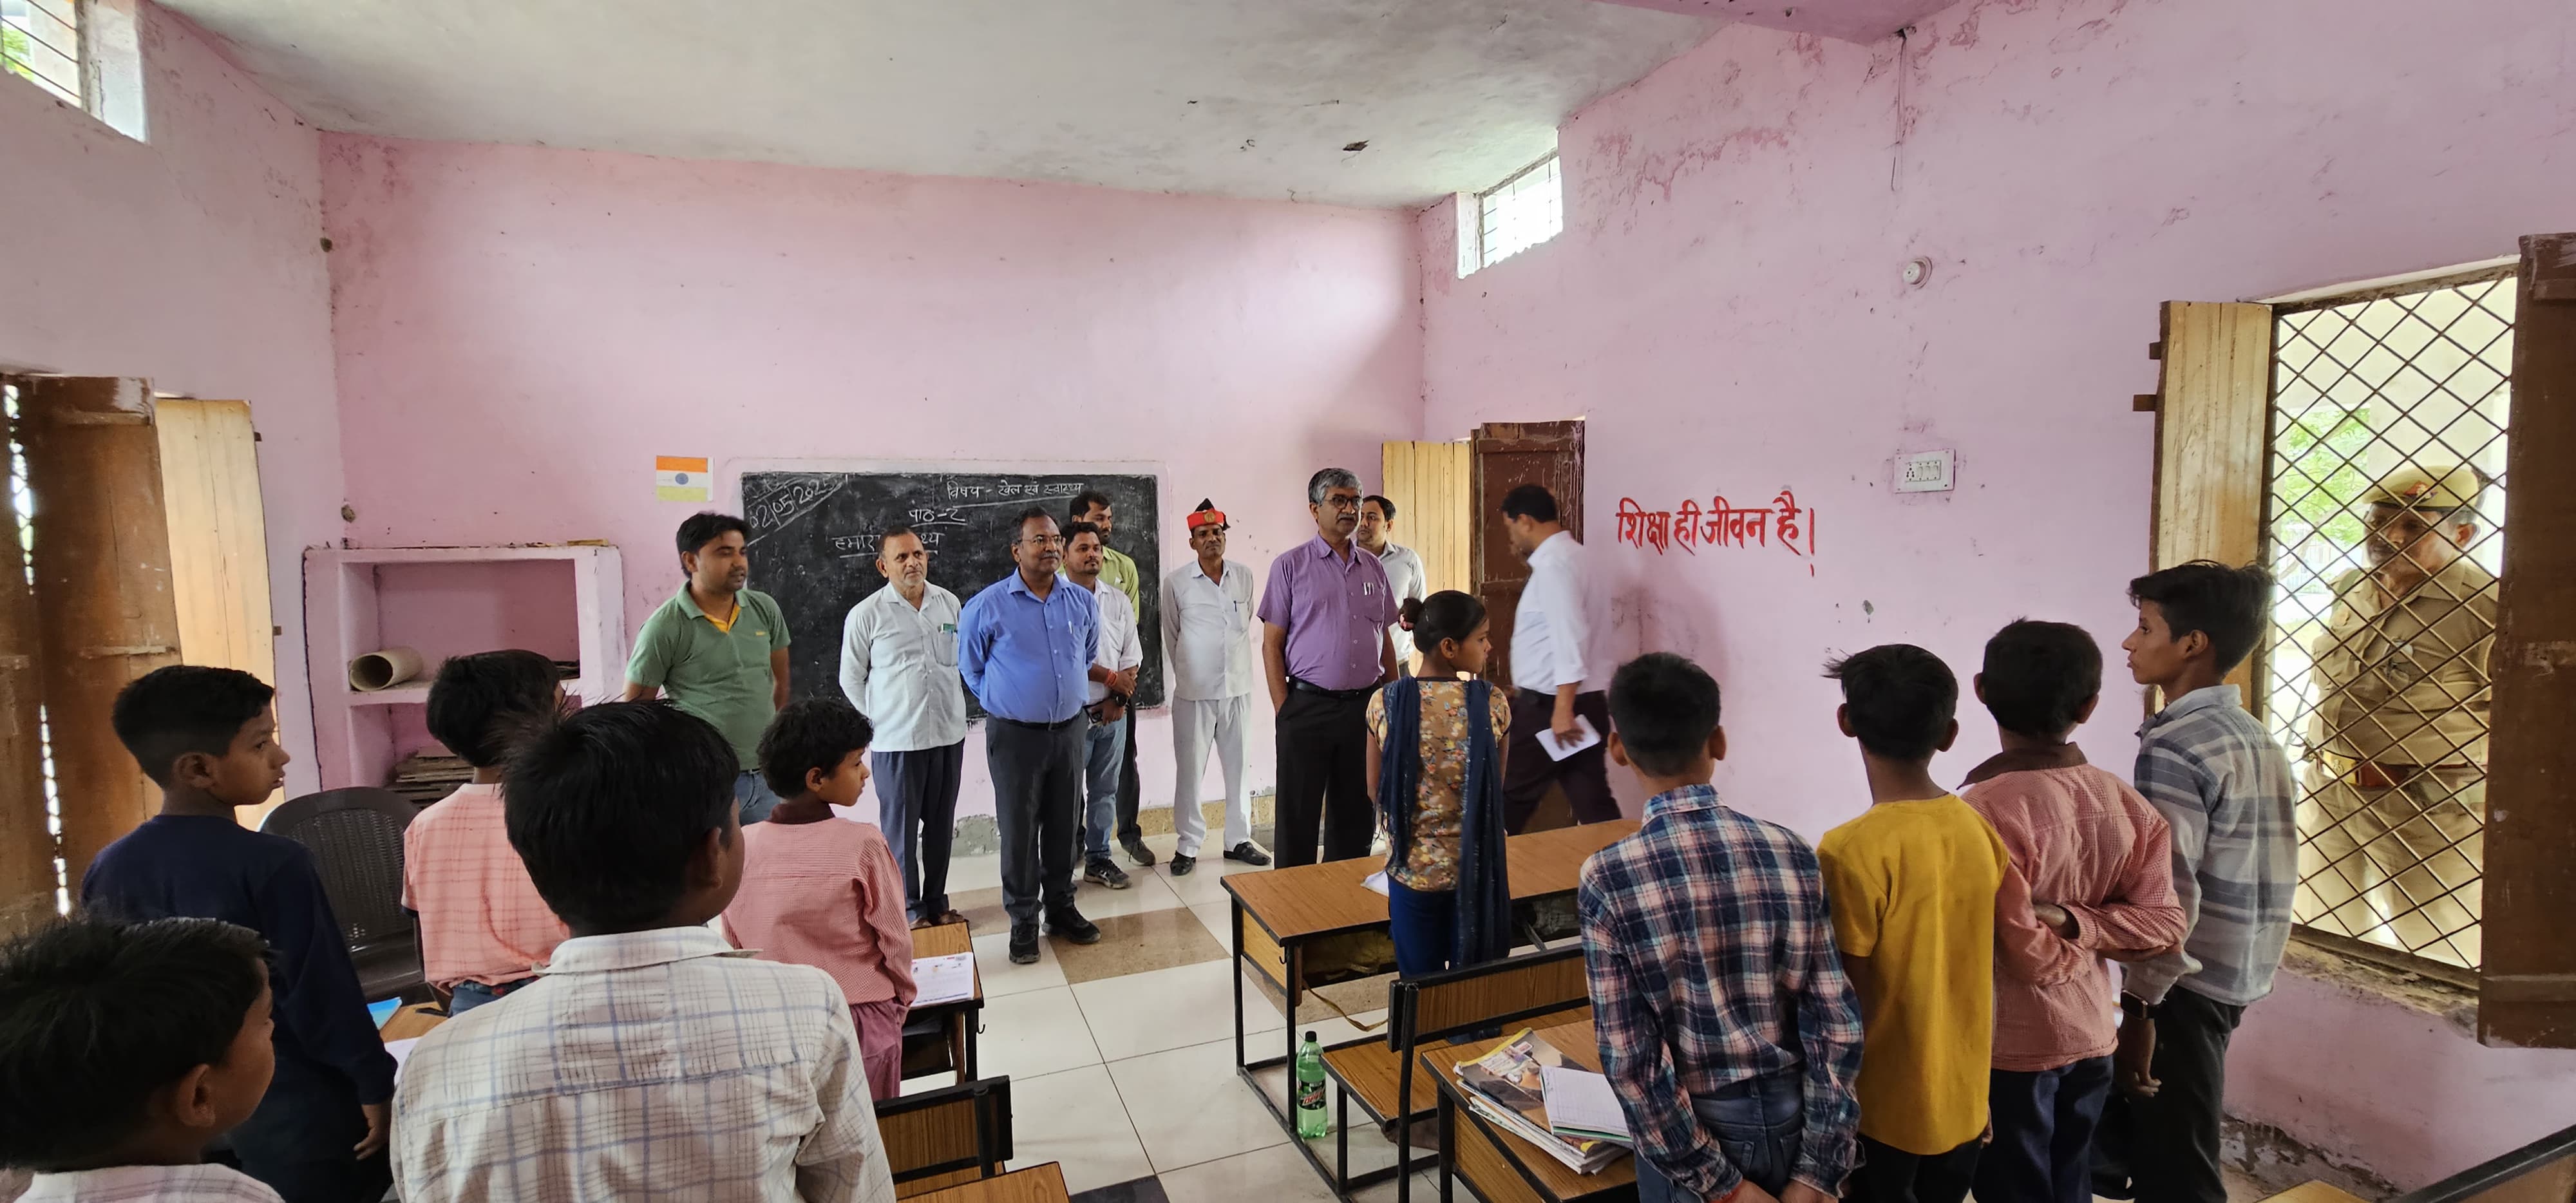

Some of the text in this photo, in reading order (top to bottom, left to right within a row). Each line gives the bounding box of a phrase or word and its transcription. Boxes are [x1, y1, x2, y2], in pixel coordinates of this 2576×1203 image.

[947, 480, 985, 500] विषय
[997, 479, 1023, 496] खेल
[1615, 497, 1671, 555] शिक्षा
[1674, 499, 1702, 556] ही
[1700, 495, 1775, 549] जीवन
